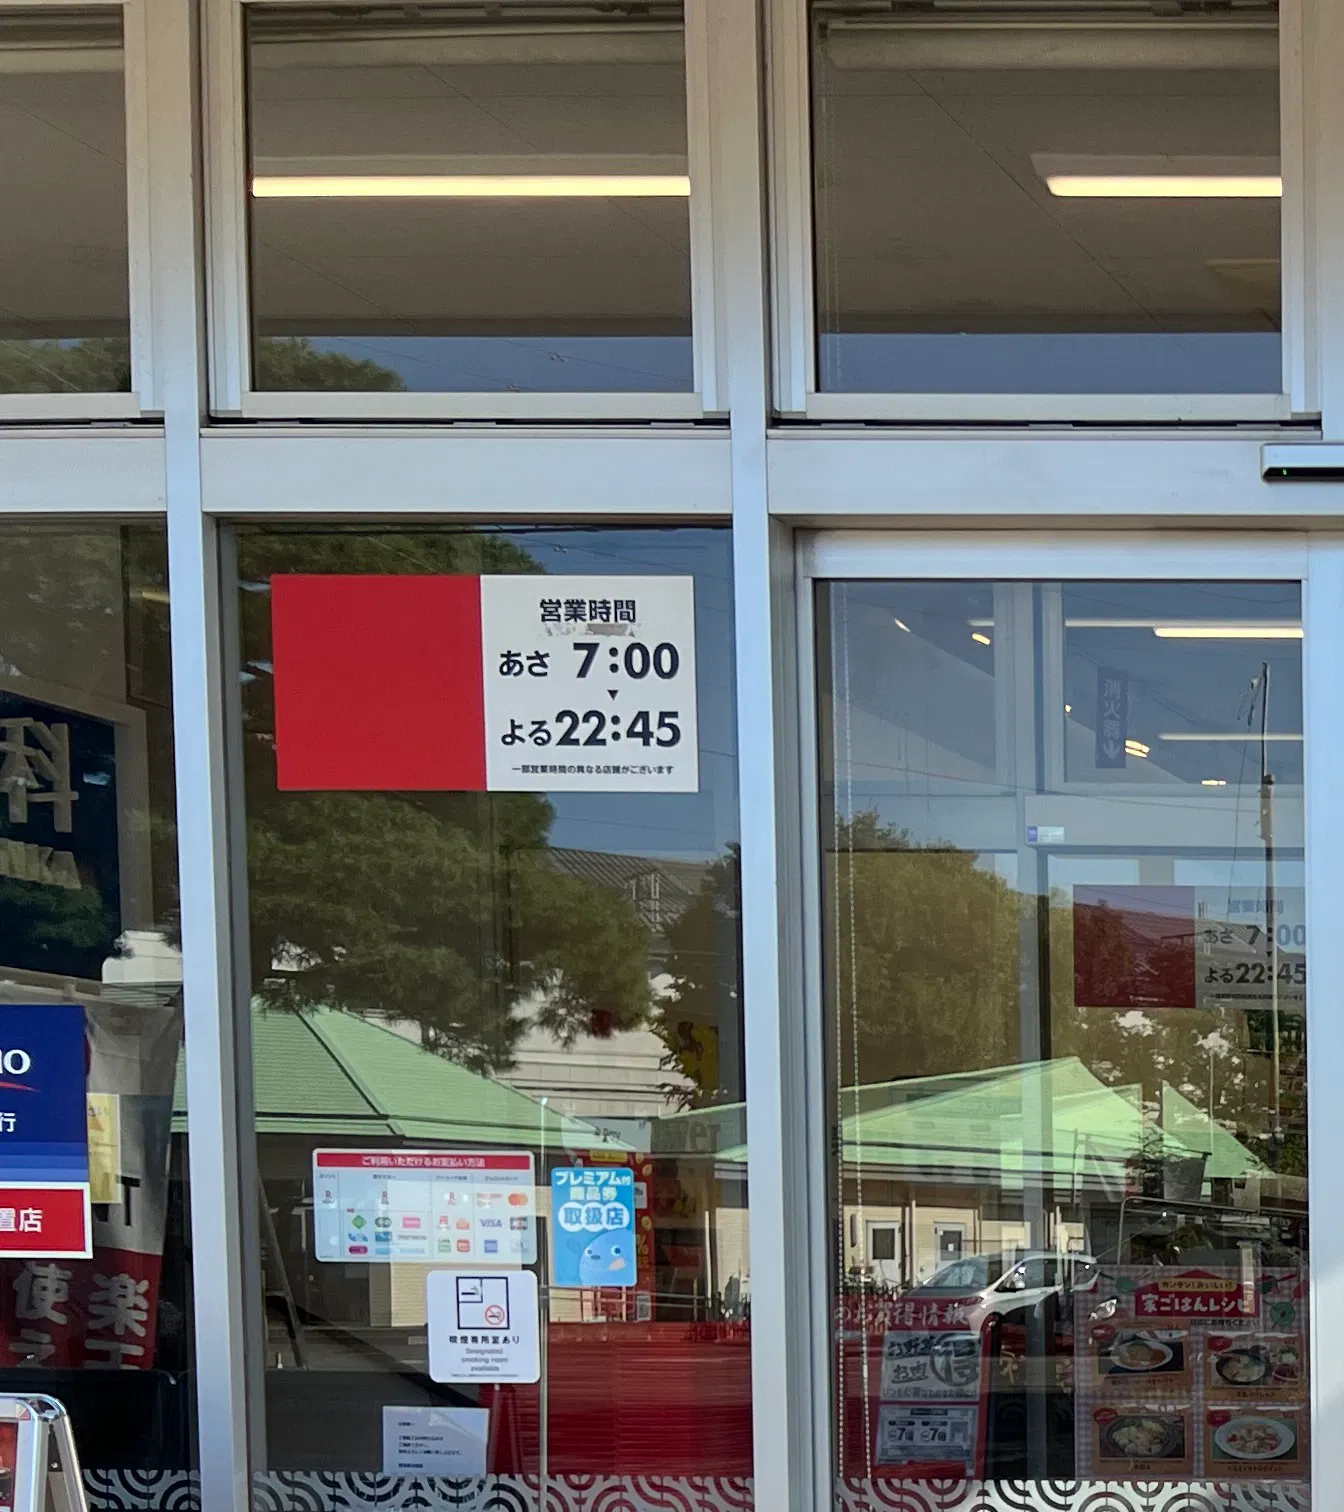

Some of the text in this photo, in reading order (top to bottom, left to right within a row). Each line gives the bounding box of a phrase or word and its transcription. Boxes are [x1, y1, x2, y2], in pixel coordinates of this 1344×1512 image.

[539, 599, 636, 622] 営業時間
[499, 642, 680, 680] あさ 7:00
[501, 710, 681, 747] よる 22:45
[1204, 962, 1306, 985] よる 22:45
[555, 1170, 632, 1187] プレミアム付
[563, 1206, 625, 1227] 取扱店
